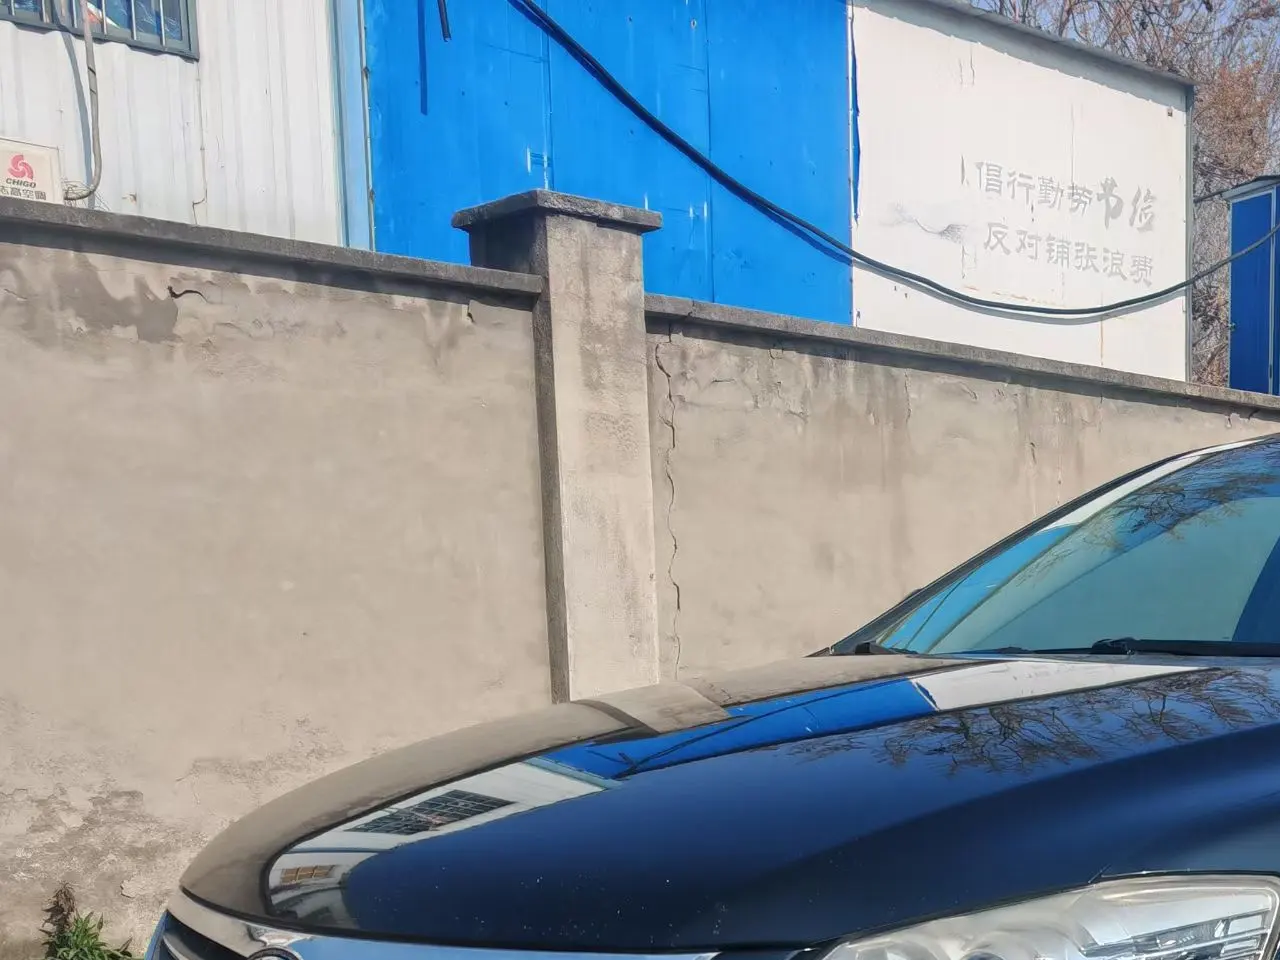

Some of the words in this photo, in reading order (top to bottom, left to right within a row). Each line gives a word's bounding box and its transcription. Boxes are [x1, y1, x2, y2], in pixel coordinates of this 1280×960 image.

[6, 178, 36, 188] CHIGO
[975, 161, 1157, 232] 倡行勤劳节俭
[983, 223, 1154, 286] 反对铺张浪费
